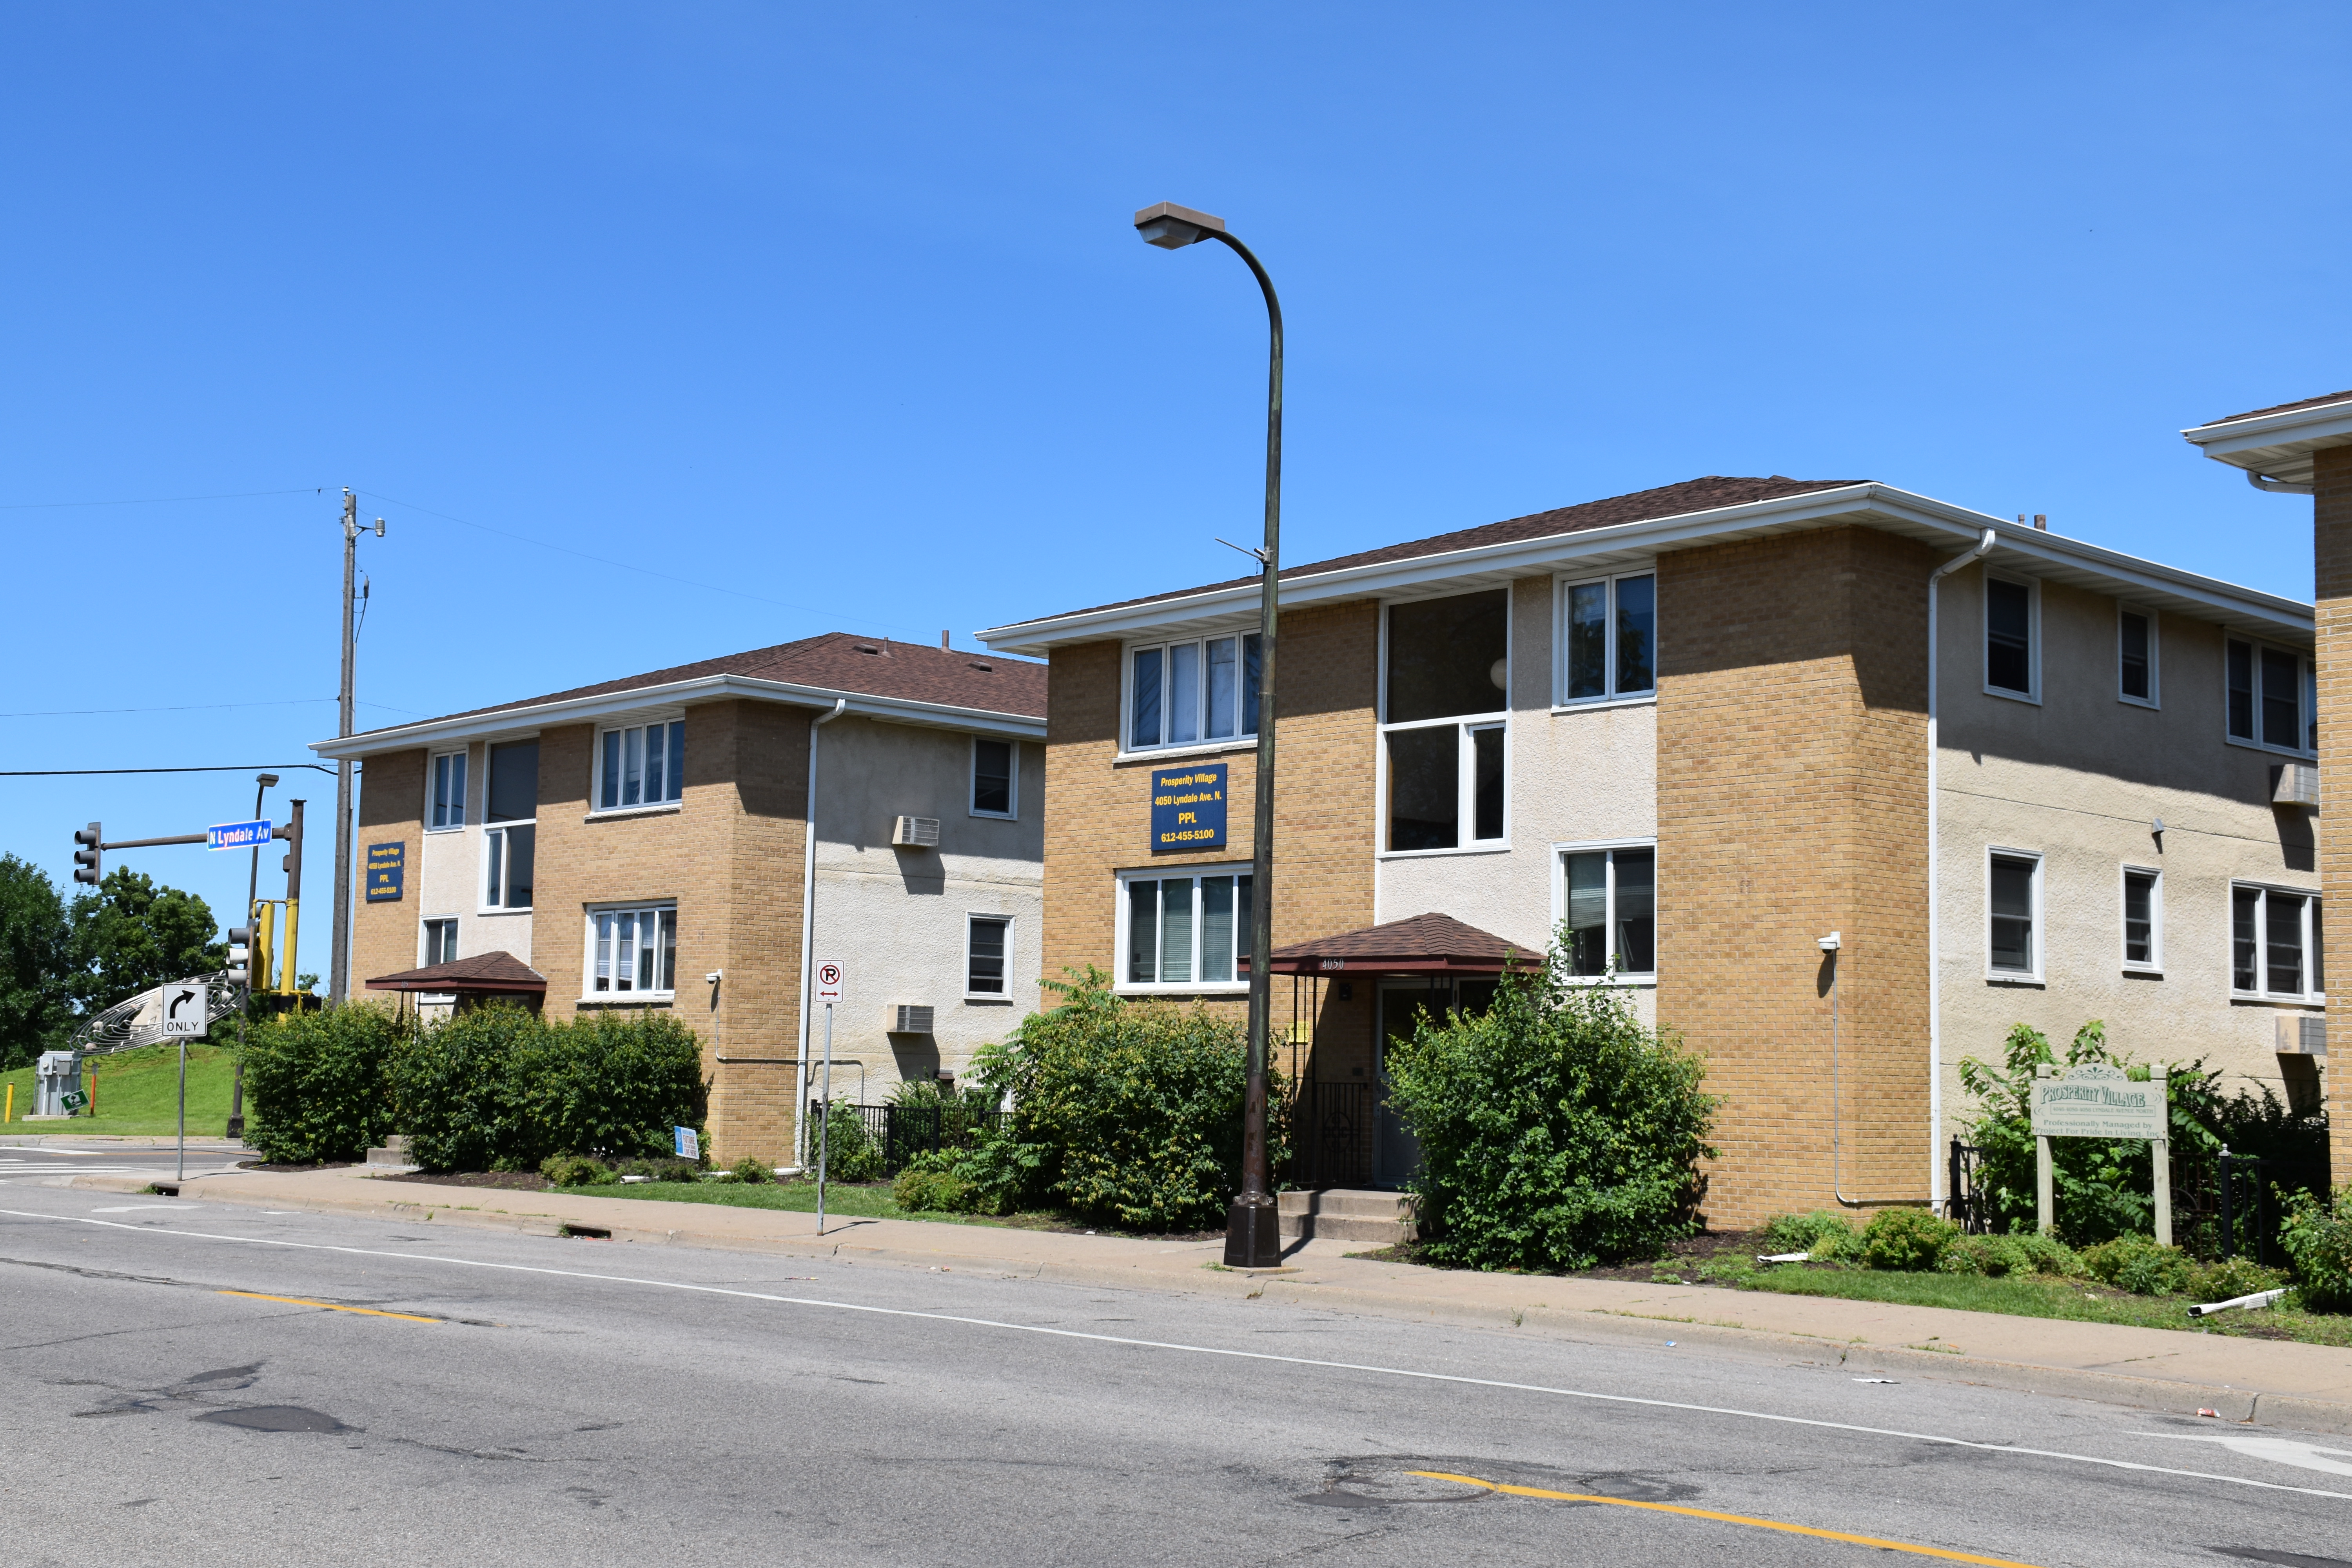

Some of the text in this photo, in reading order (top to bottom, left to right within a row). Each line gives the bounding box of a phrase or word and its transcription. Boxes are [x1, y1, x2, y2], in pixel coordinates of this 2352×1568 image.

[1161, 773, 1217, 787] Prosperity Village
[1155, 791, 1222, 806] 4050 Lyndale Ave. N.
[1178, 812, 1197, 824] PPL
[210, 826, 269, 847] N Lyndale Av
[1161, 829, 1214, 842] 612-455-5100
[378, 862, 390, 870] Lyndale
[379, 874, 389, 883] PPL
[371, 886, 397, 895] 612-455-5100
[1323, 958, 1344, 970] 4050
[167, 1022, 199, 1032] ONLY
[2040, 1085, 2146, 1107] PROSPERITY VILLAGE
[2043, 1120, 2100, 1129] Professionally
[2102, 1121, 2140, 1129] Managed
[683, 1135, 695, 1144] FUTURE
